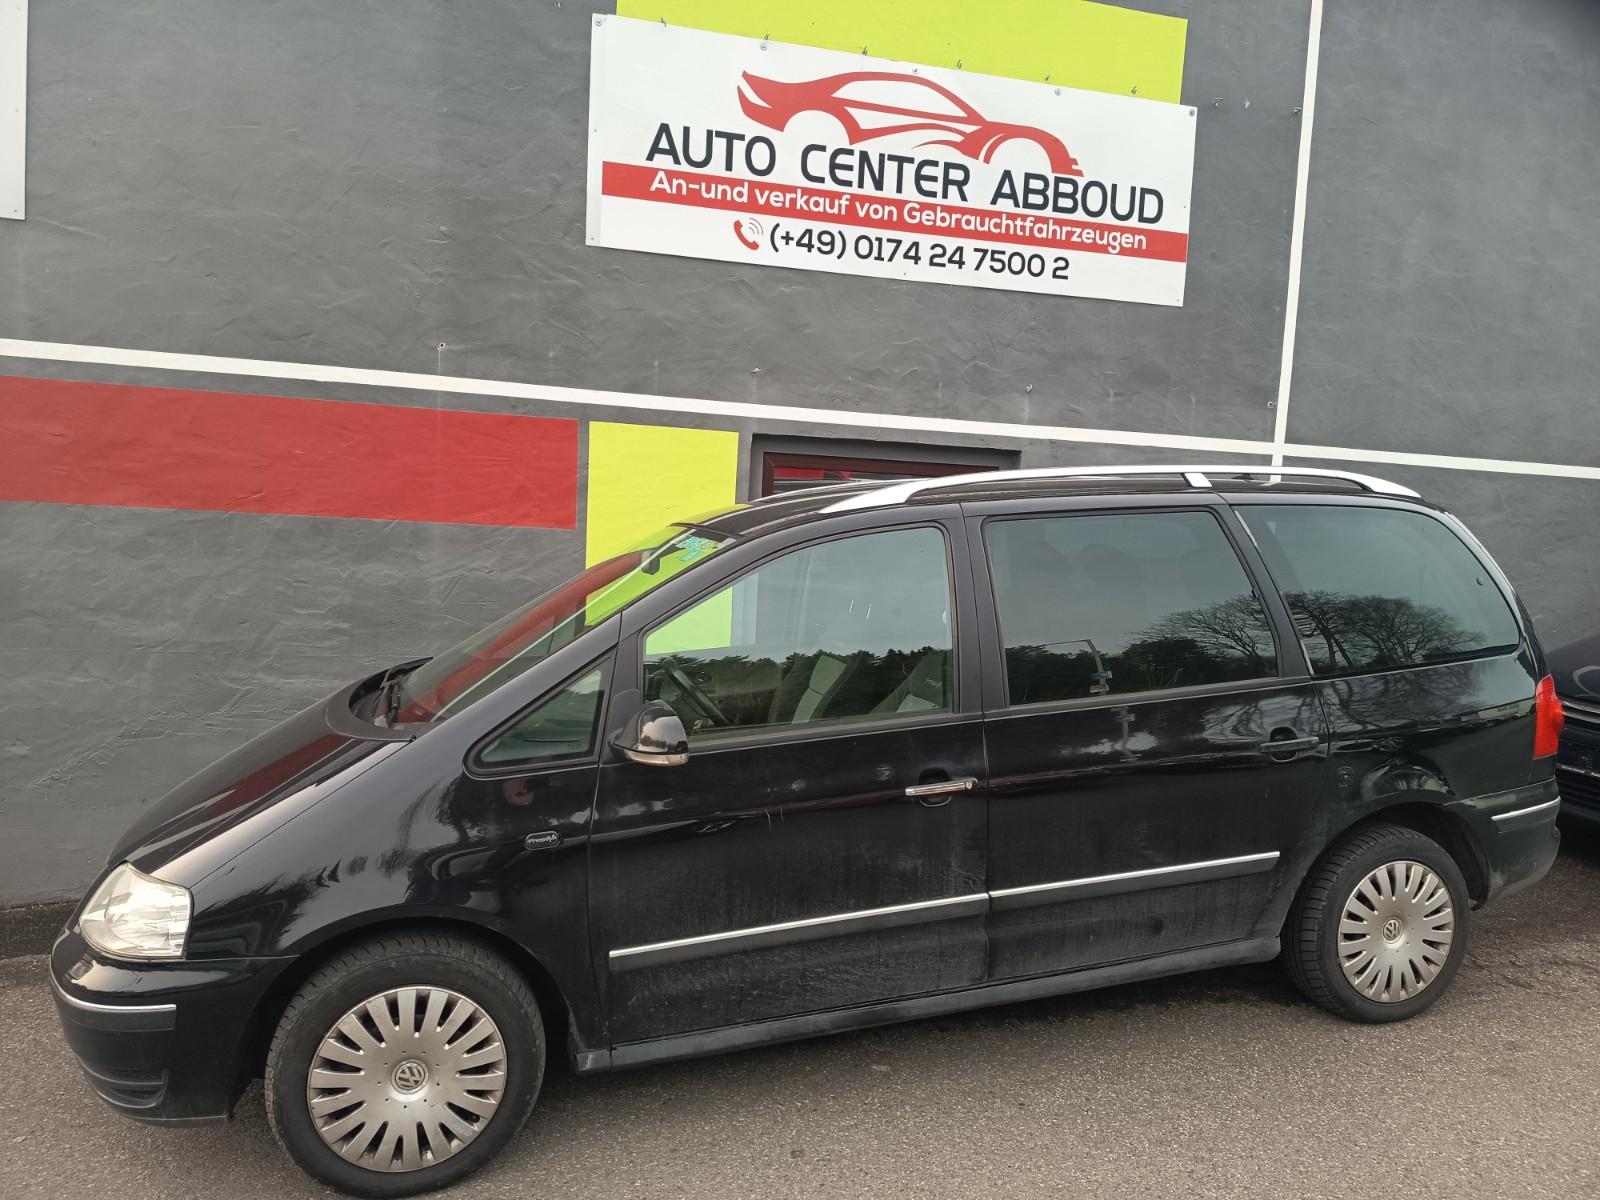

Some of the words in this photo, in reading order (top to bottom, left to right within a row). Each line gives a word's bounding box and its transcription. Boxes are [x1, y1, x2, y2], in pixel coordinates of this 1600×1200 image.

[645, 122, 776, 177] AUTO
[800, 143, 971, 202] CENTER
[989, 169, 1164, 225] ABBOUD
[649, 170, 749, 203] An-und
[754, 188, 851, 215] verkauf
[855, 201, 898, 222] von
[903, 202, 1147, 254] Gebrauchtfahrzeugen
[770, 222, 847, 260] (+49)
[854, 234, 922, 265] 0174
[928, 243, 966, 270] 24
[973, 247, 1046, 278] 7500
[1051, 256, 1070, 280] 2
